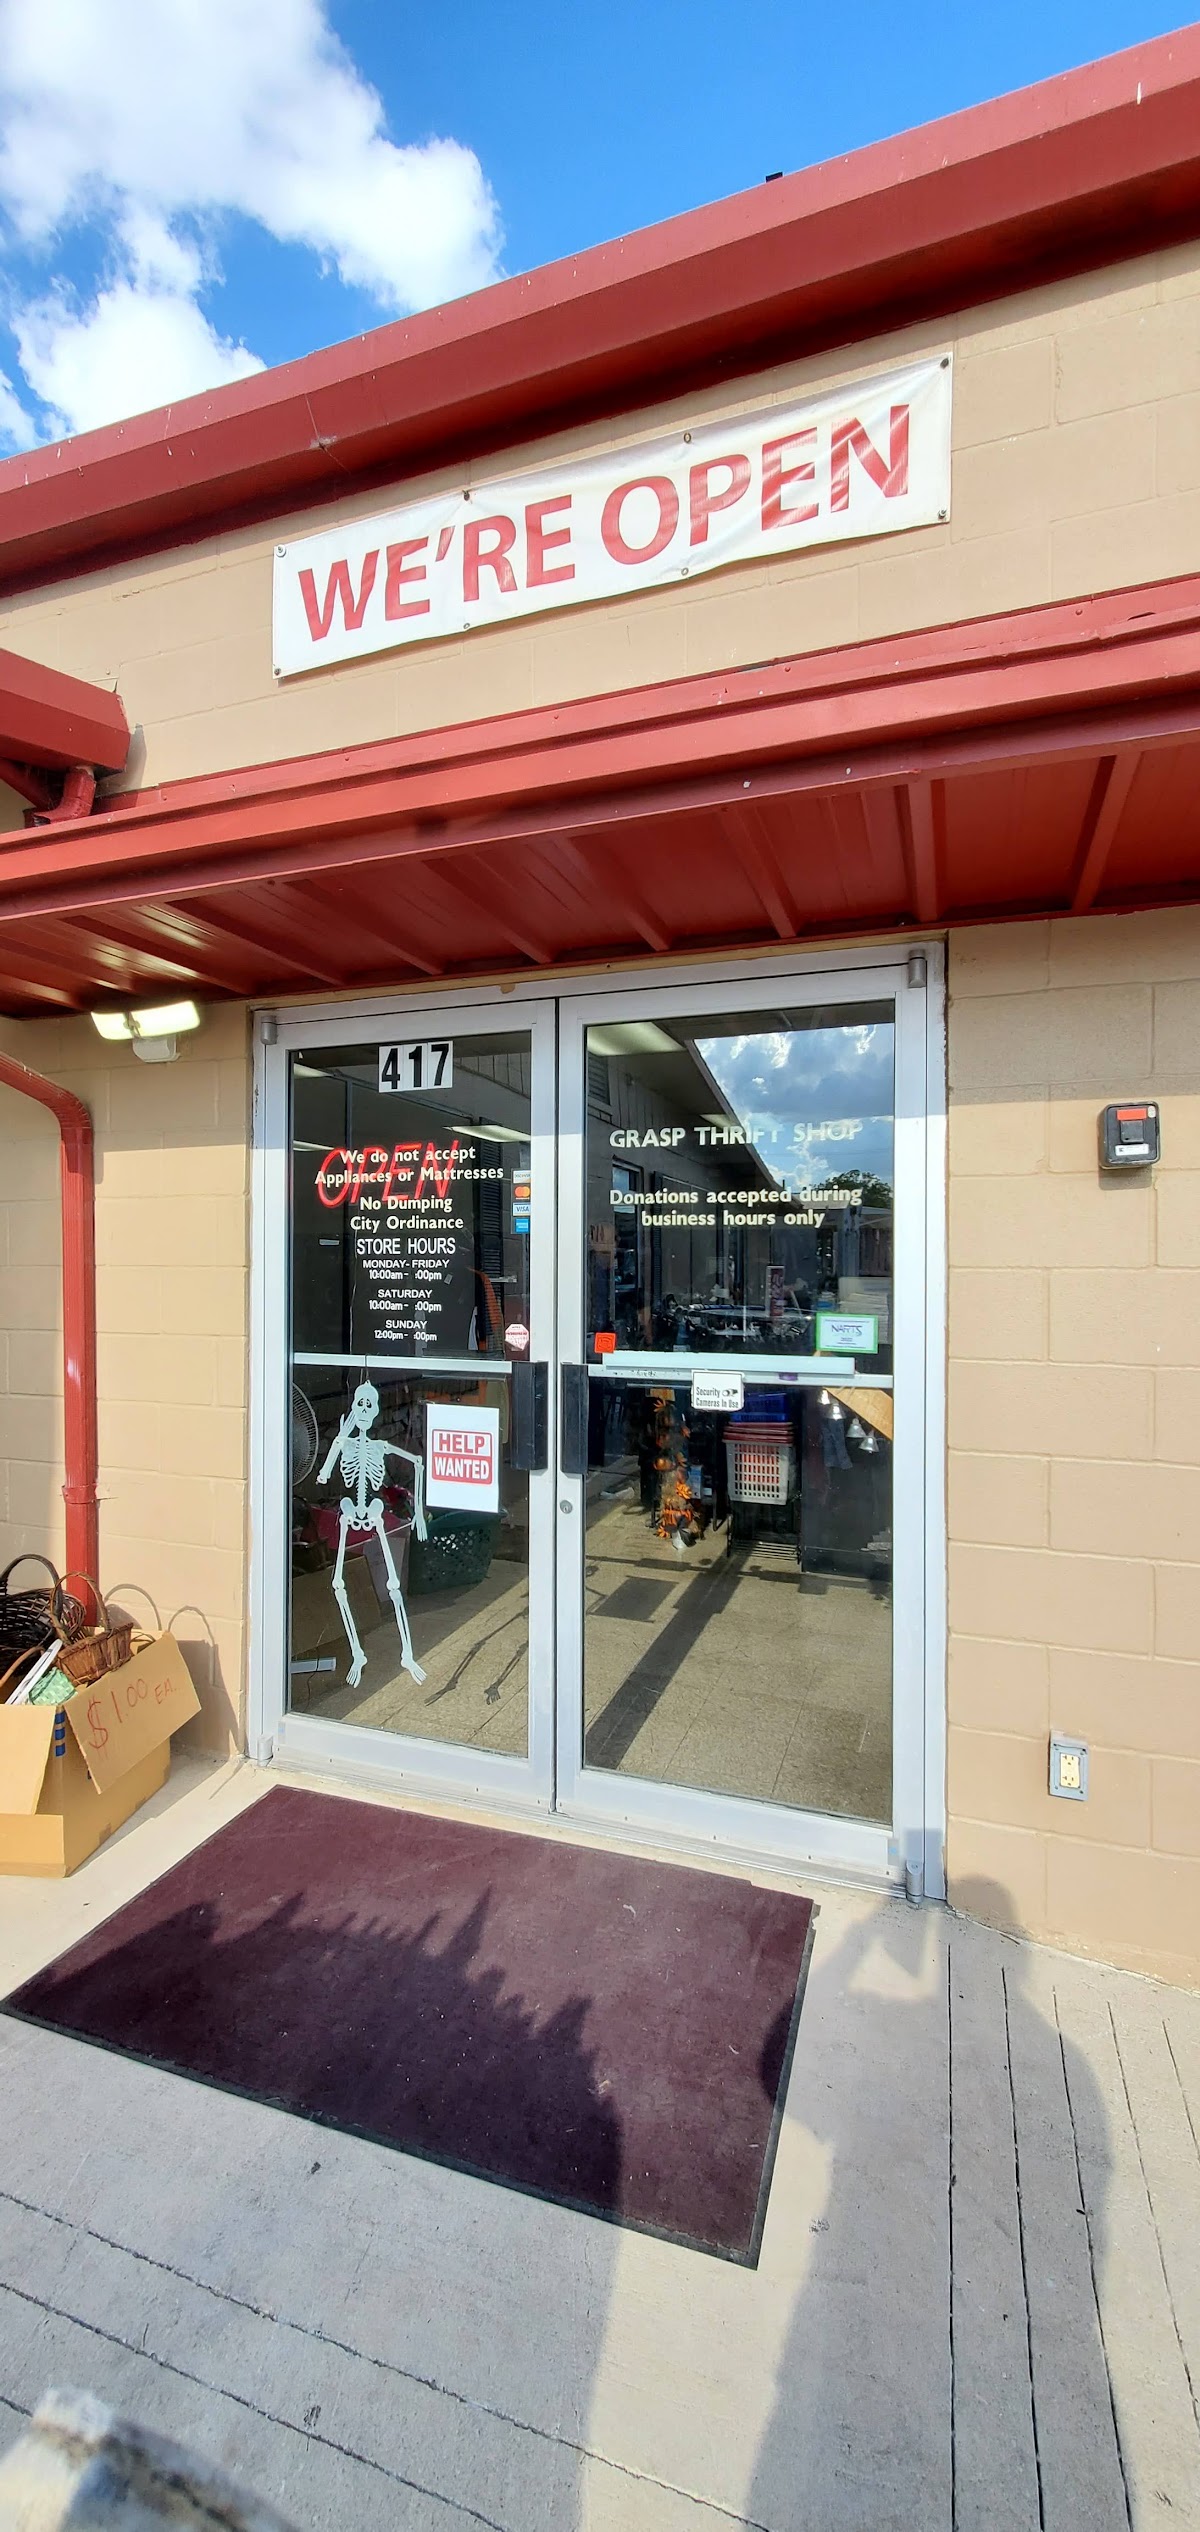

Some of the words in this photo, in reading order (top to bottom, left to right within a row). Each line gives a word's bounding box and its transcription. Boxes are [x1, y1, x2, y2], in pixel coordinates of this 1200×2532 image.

[600, 404, 911, 565] OPEN
[382, 1043, 449, 1089] 417
[609, 1127, 686, 1149] GRASP
[694, 1125, 783, 1146] THRIFT
[793, 1118, 863, 1143] SHOP
[339, 1149, 365, 1164] We
[370, 1150, 389, 1163] do
[394, 1149, 420, 1162] not
[425, 1146, 476, 1163] accept
[314, 1170, 392, 1188] Appliances
[397, 1172, 415, 1182] or
[420, 1166, 504, 1181] Mattresses
[317, 1139, 460, 1209] OPEN
[360, 1196, 382, 1211] No
[387, 1195, 453, 1212] Dumping
[609, 1188, 699, 1205] Donations
[706, 1187, 792, 1207] accepted
[801, 1185, 862, 1206] during
[350, 1216, 381, 1234] City
[386, 1214, 464, 1230] Ordinance
[641, 1210, 716, 1227] business
[723, 1210, 776, 1226] hours
[784, 1209, 825, 1229] only
[356, 1238, 401, 1255] STORE
[407, 1237, 456, 1254] HOURS
[411, 1260, 450, 1269] FRIDAY
[377, 1289, 433, 1298] SATURDAY
[385, 1319, 428, 1329] SUNDAY
[696, 1386, 721, 1398] Security
[696, 1398, 720, 1408] Cameras
[721, 1398, 727, 1408] In
[728, 1399, 739, 1409] Use
[438, 1433, 485, 1454] HELP
[434, 1456, 490, 1480] WANTED
[86, 1678, 148, 1760] $1.00
